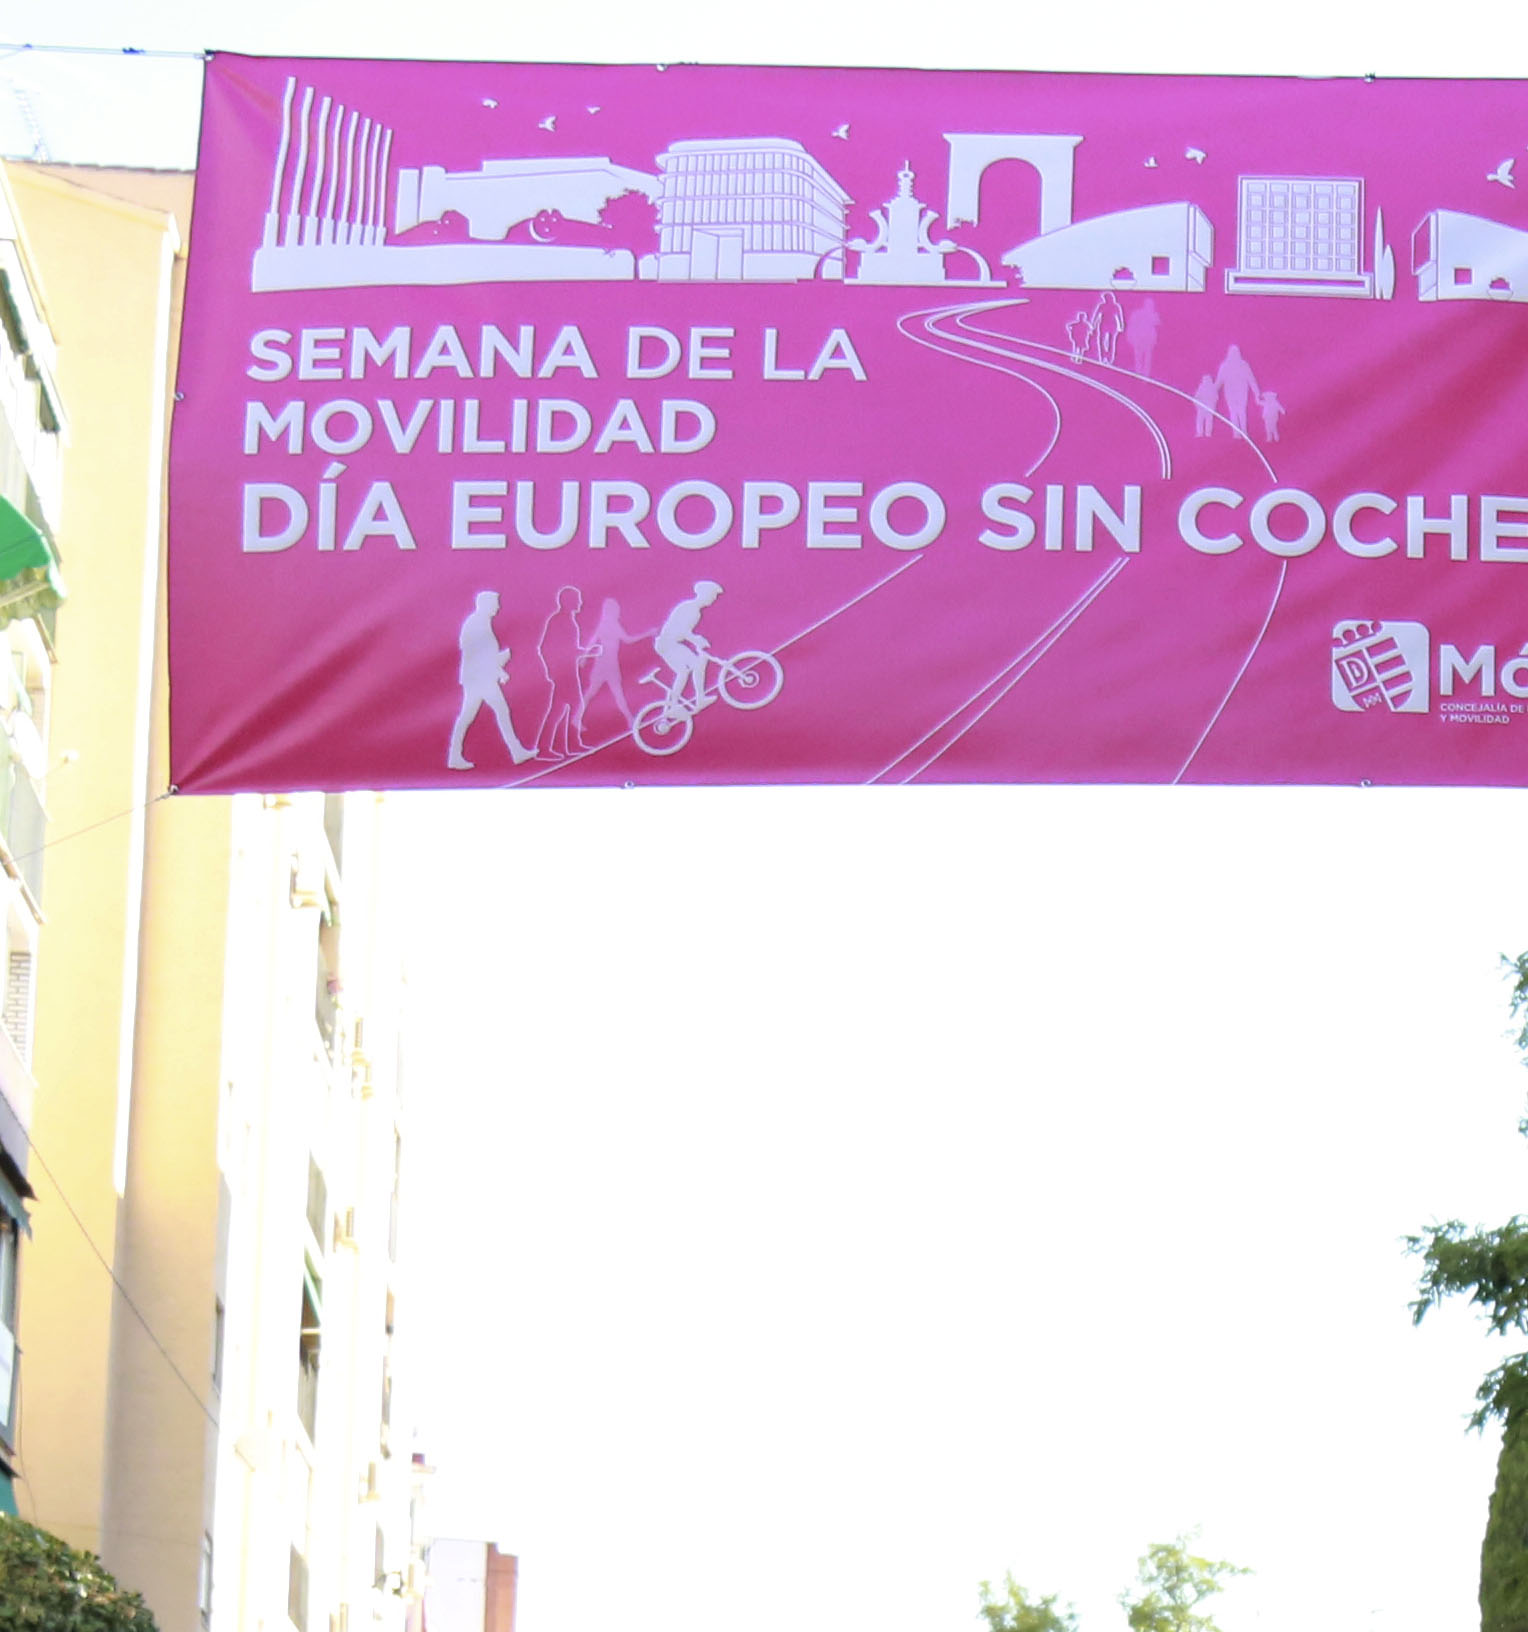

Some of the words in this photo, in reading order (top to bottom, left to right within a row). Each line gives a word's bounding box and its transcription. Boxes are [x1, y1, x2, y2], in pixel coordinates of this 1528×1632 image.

[245, 323, 600, 382] SEMANA
[625, 324, 736, 380] DE
[762, 326, 868, 381] LA
[242, 397, 718, 456] MOVILIDAD
[241, 461, 417, 554] DÍA
[450, 478, 947, 552] EUROPEO
[977, 481, 1143, 553] SIN
[1439, 701, 1508, 713] CONCEJALÍA
[1510, 703, 1525, 714] DE
[1439, 713, 1448, 723] Y
[1449, 713, 1511, 724] MOVILIDAD
